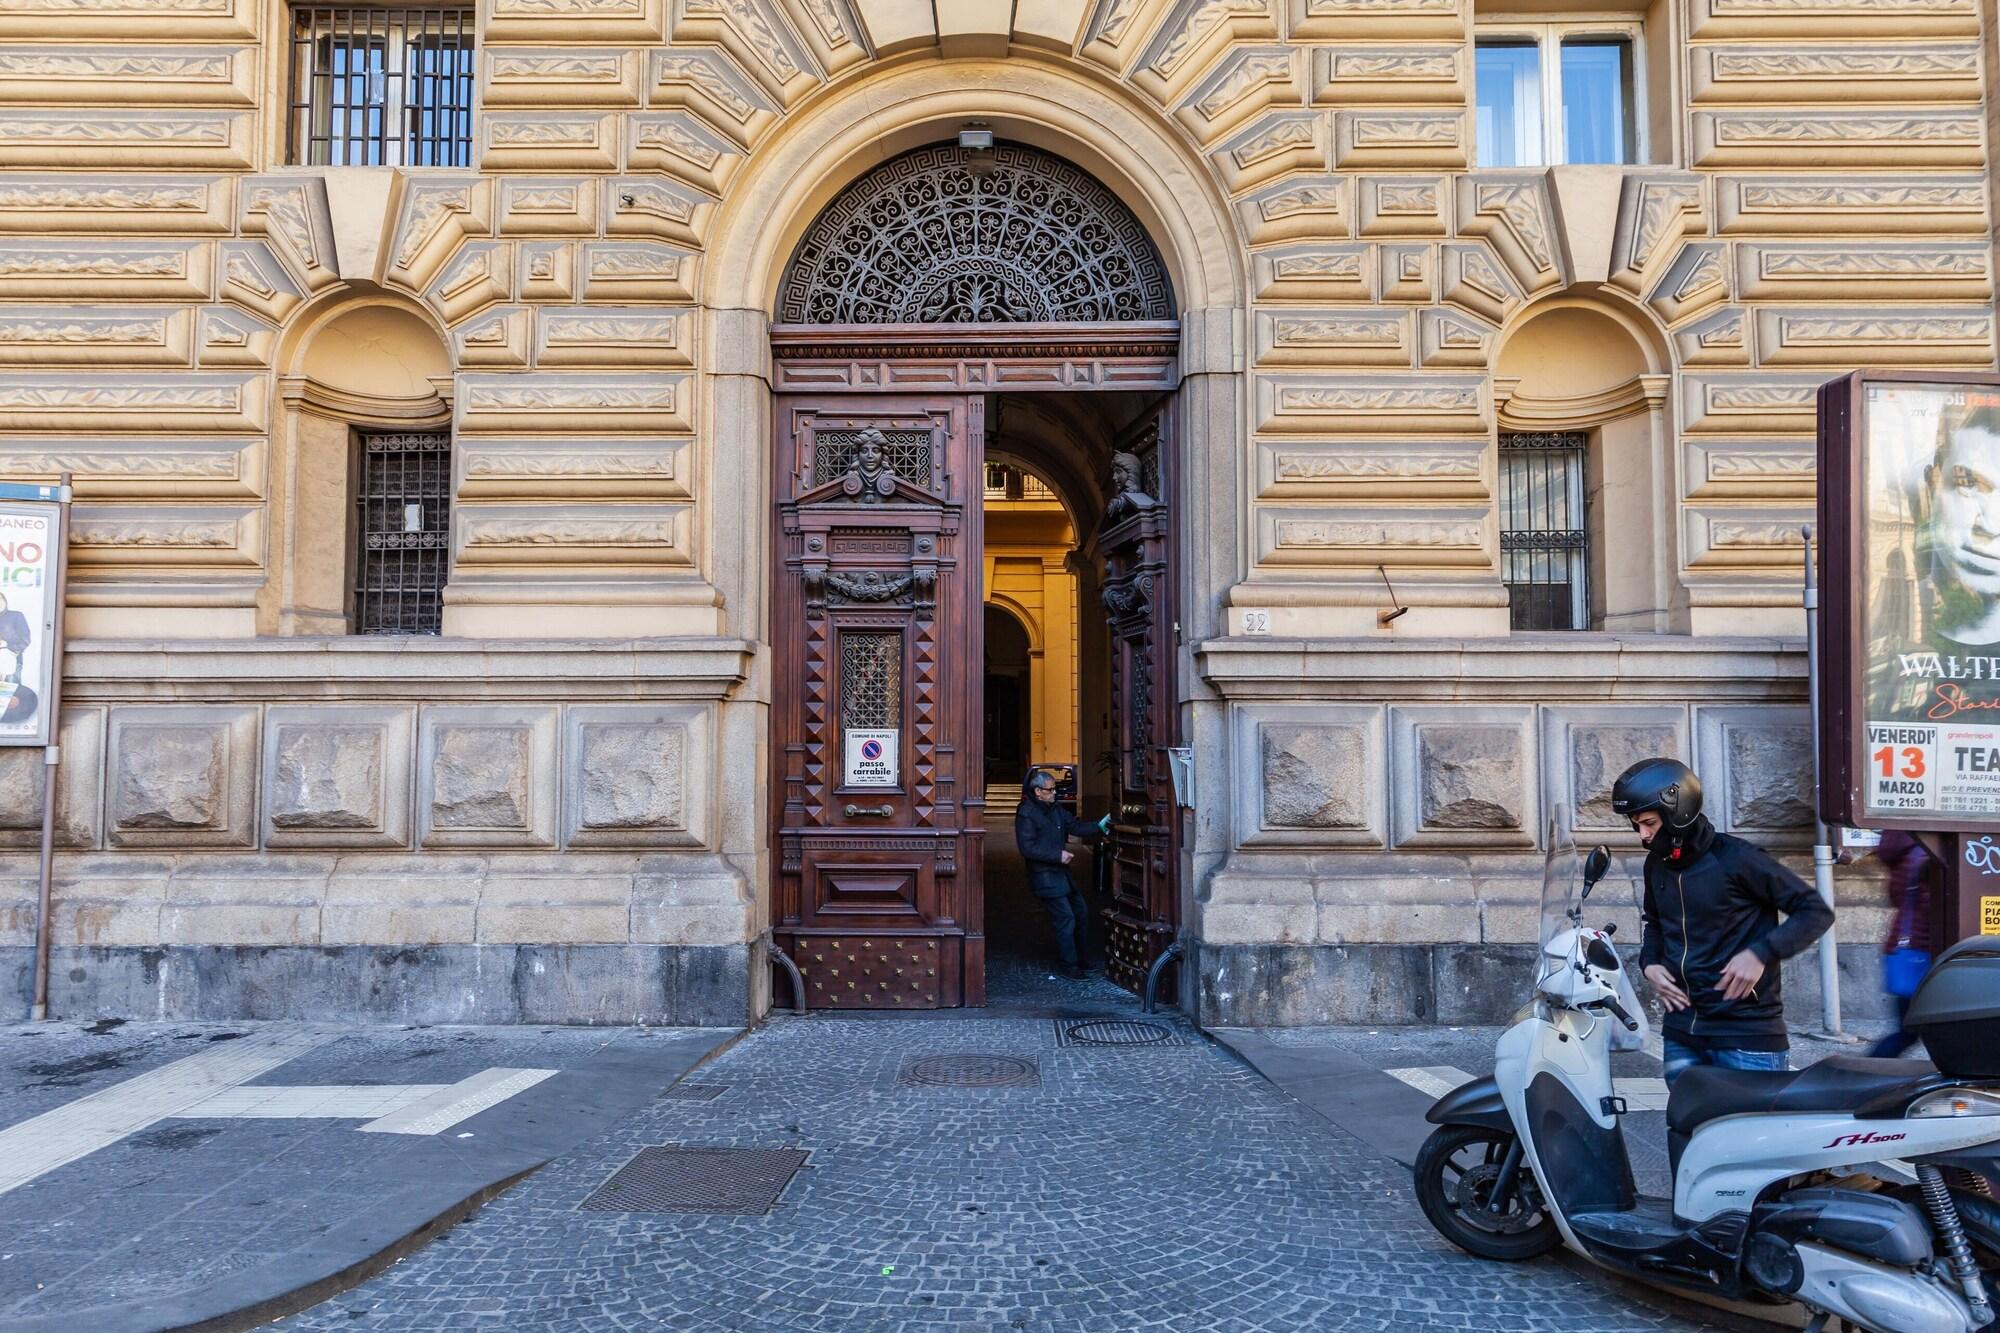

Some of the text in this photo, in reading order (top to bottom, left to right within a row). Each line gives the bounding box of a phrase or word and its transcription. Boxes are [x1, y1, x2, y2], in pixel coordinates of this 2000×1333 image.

[1246, 613, 1266, 632] 22
[1868, 727, 1936, 745] VENERDI'
[859, 761, 885, 769] passo
[1873, 746, 1926, 779] 13
[1954, 746, 2000, 772] TEA
[853, 767, 892, 776] carrabile
[1955, 773, 1968, 781] VIA
[1879, 780, 1925, 796] MARZO
[1877, 797, 1926, 808] ore 21:30
